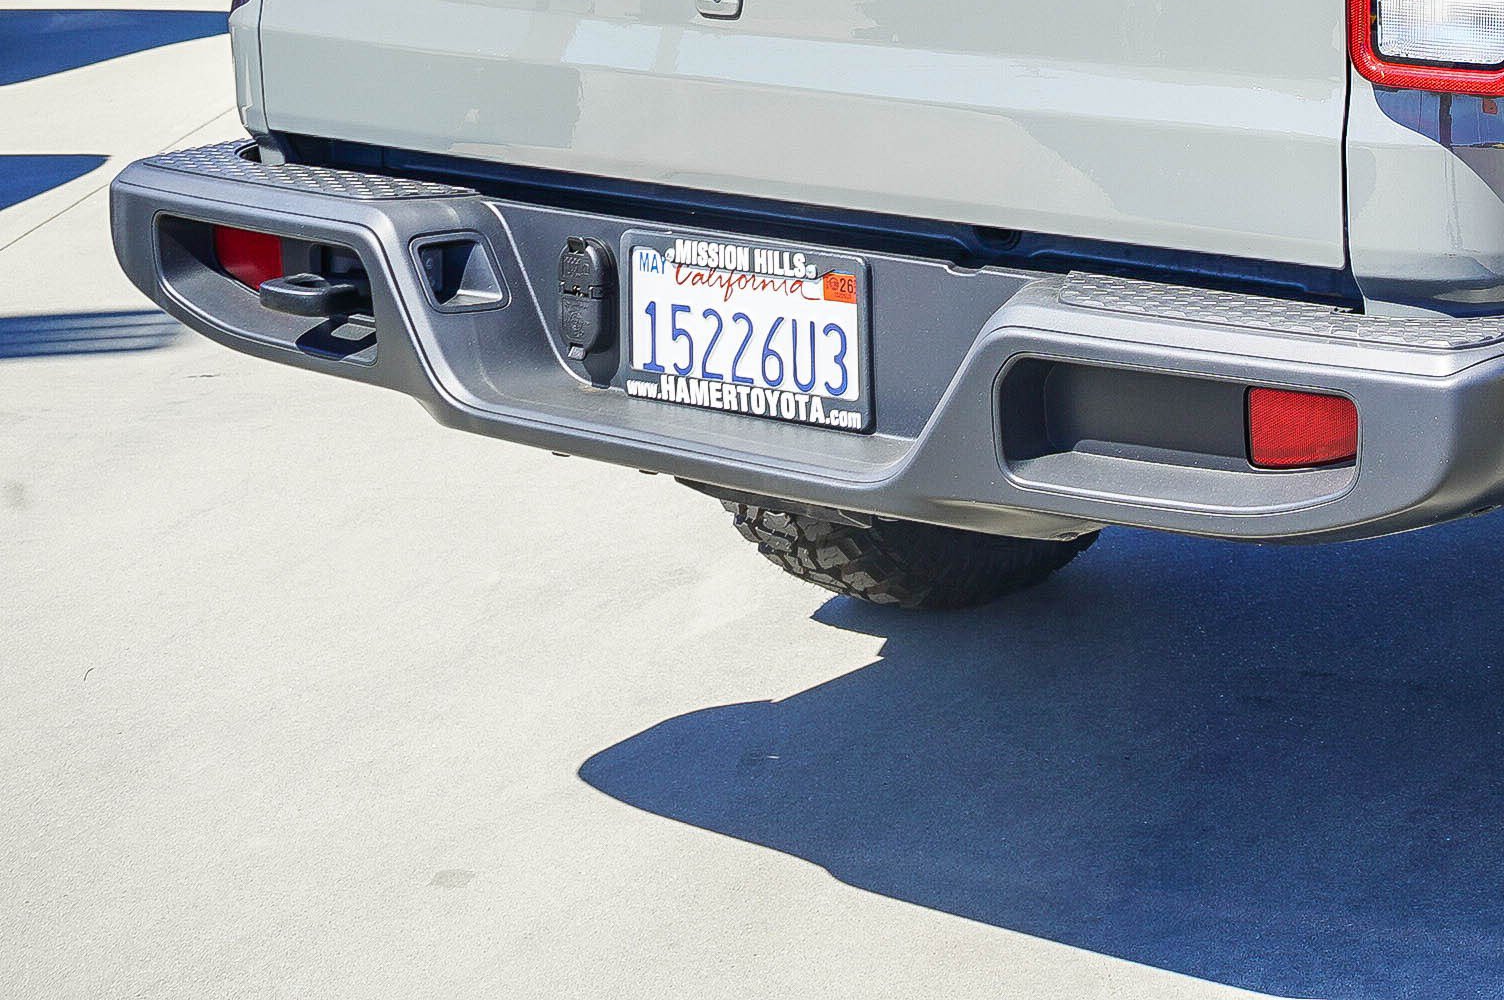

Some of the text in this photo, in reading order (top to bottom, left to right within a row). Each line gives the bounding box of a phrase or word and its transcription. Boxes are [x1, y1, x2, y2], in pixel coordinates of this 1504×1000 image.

[639, 251, 667, 275] MAY
[674, 239, 806, 275] MISSION HILLS
[674, 263, 821, 302] California
[839, 277, 854, 294] 26
[643, 300, 848, 396] 15226U3
[626, 374, 862, 430] www.HAMERTOYOTA.com
